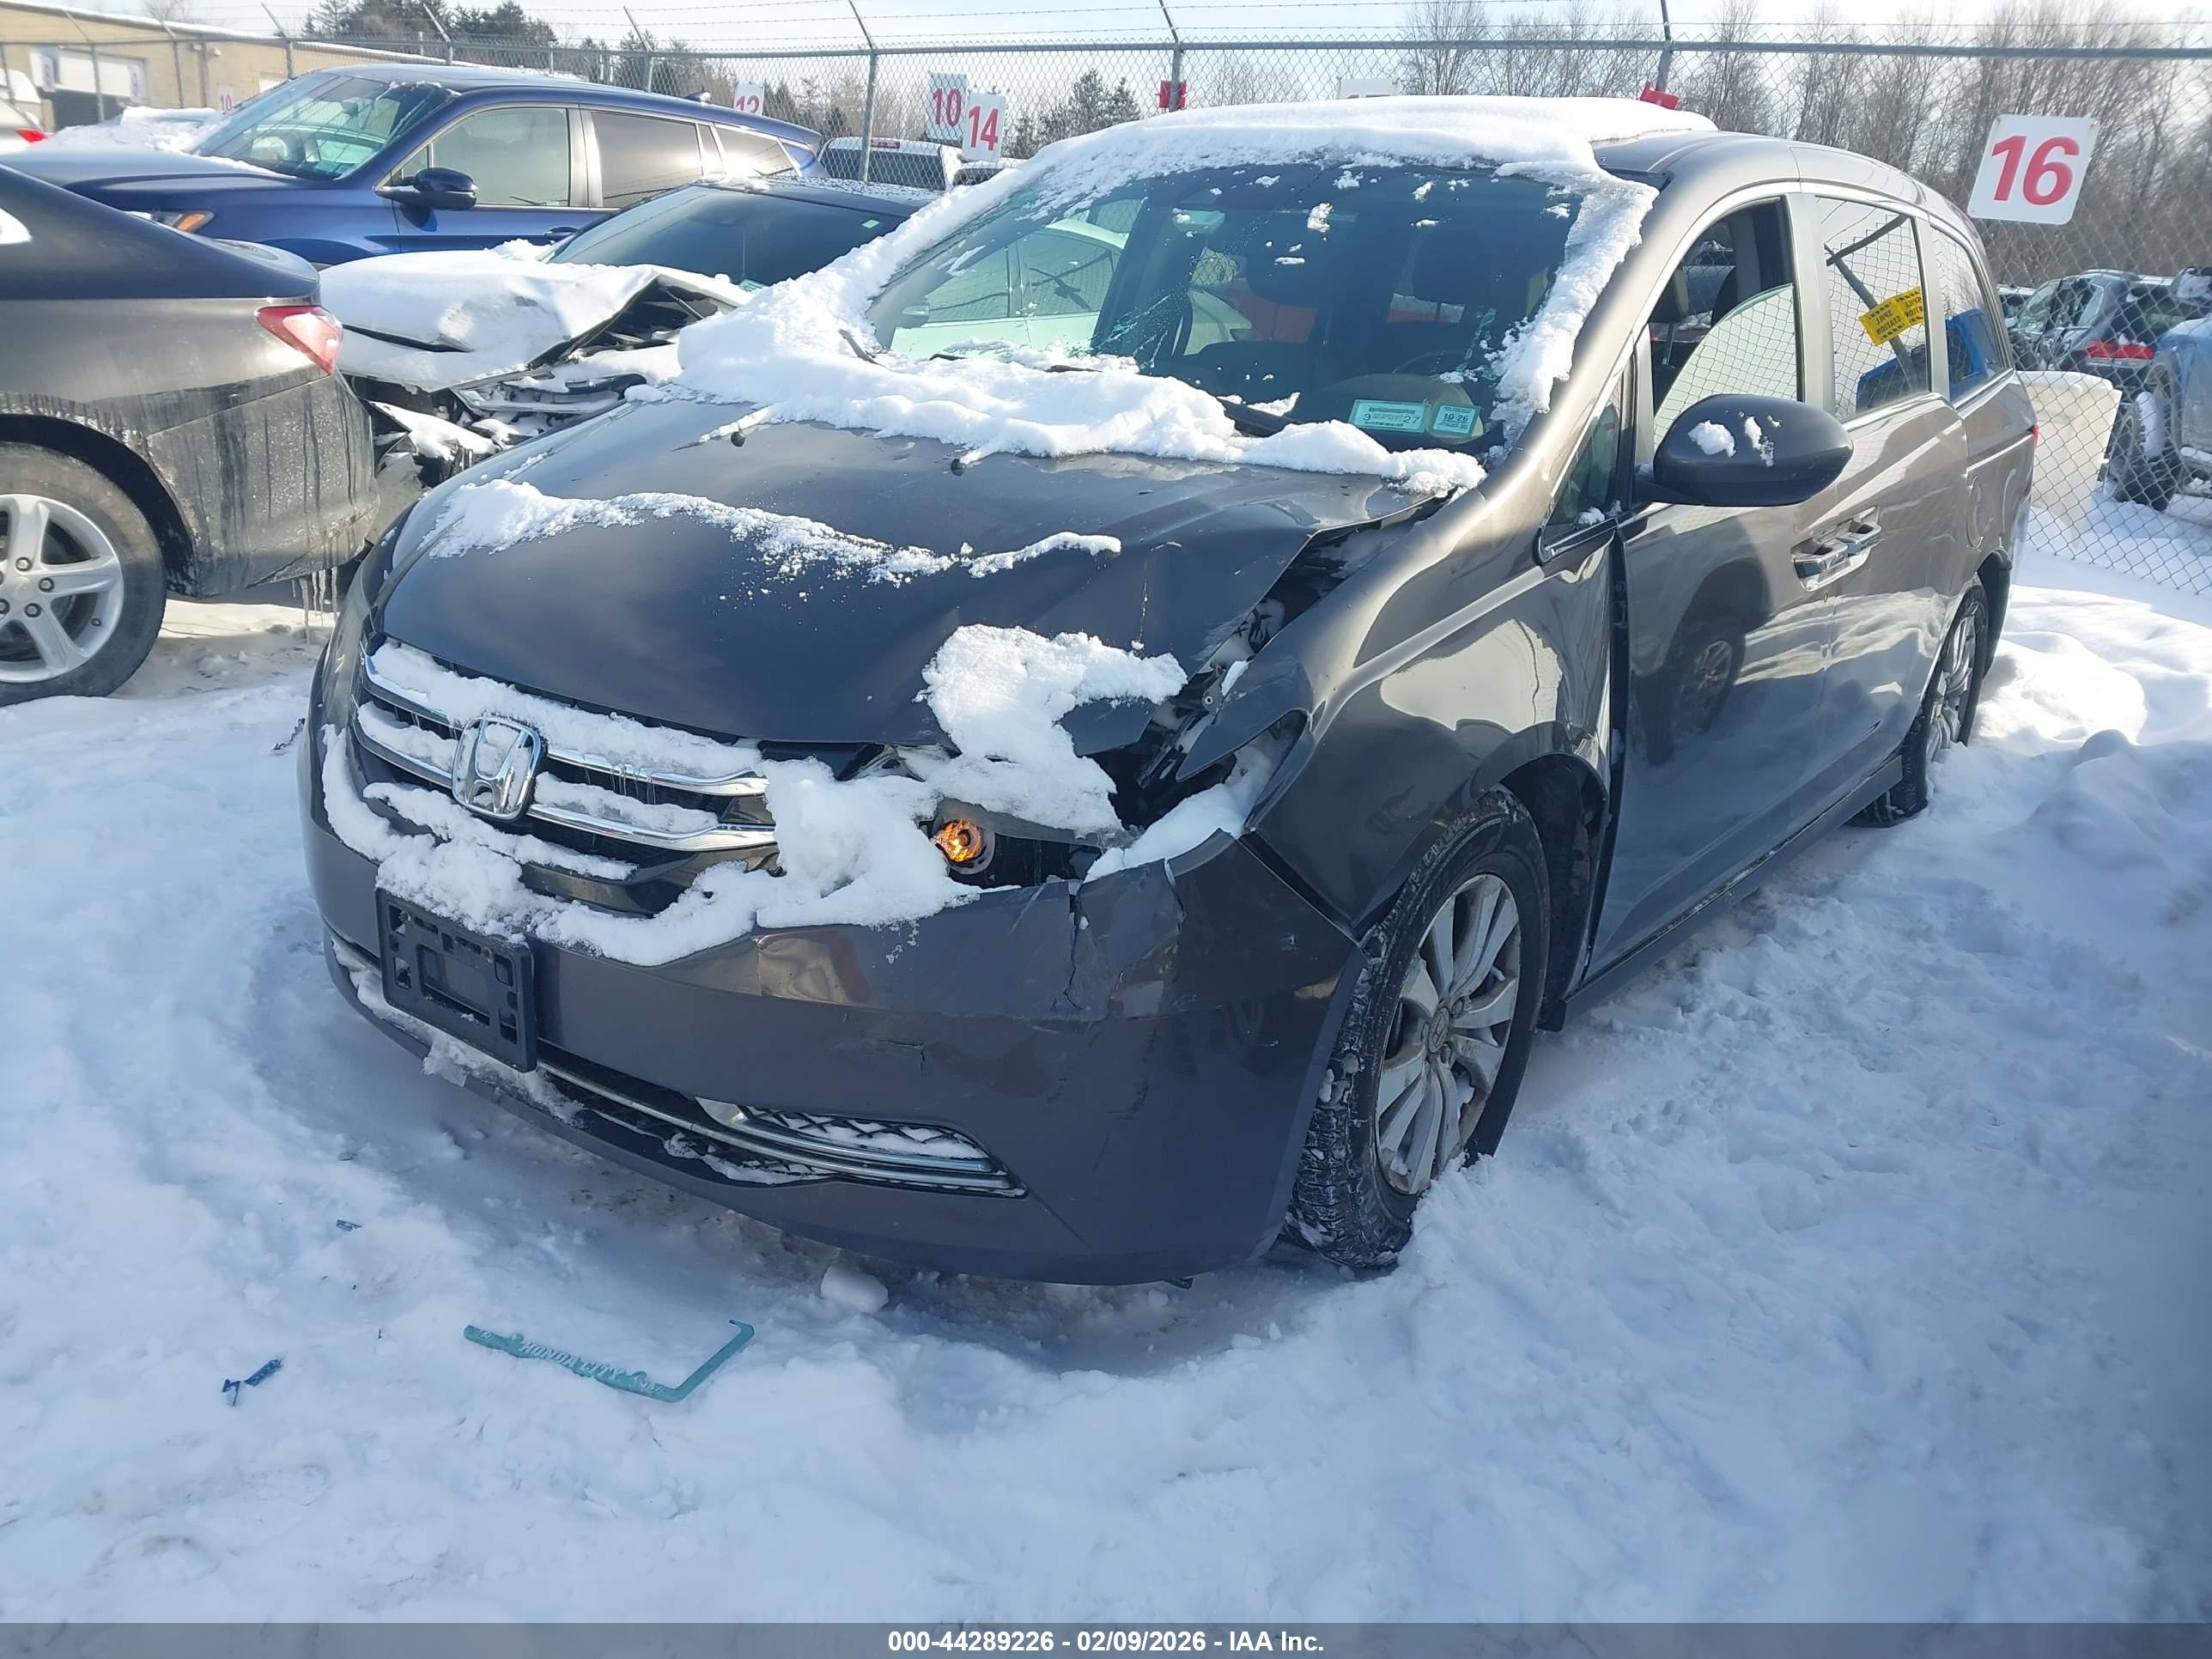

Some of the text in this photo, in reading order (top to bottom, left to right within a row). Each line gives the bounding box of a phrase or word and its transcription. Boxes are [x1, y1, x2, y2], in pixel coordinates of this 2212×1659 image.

[220, 94, 233, 112] 10
[933, 88, 962, 127] 10
[968, 105, 999, 151] 14
[1991, 135, 2080, 205] 16
